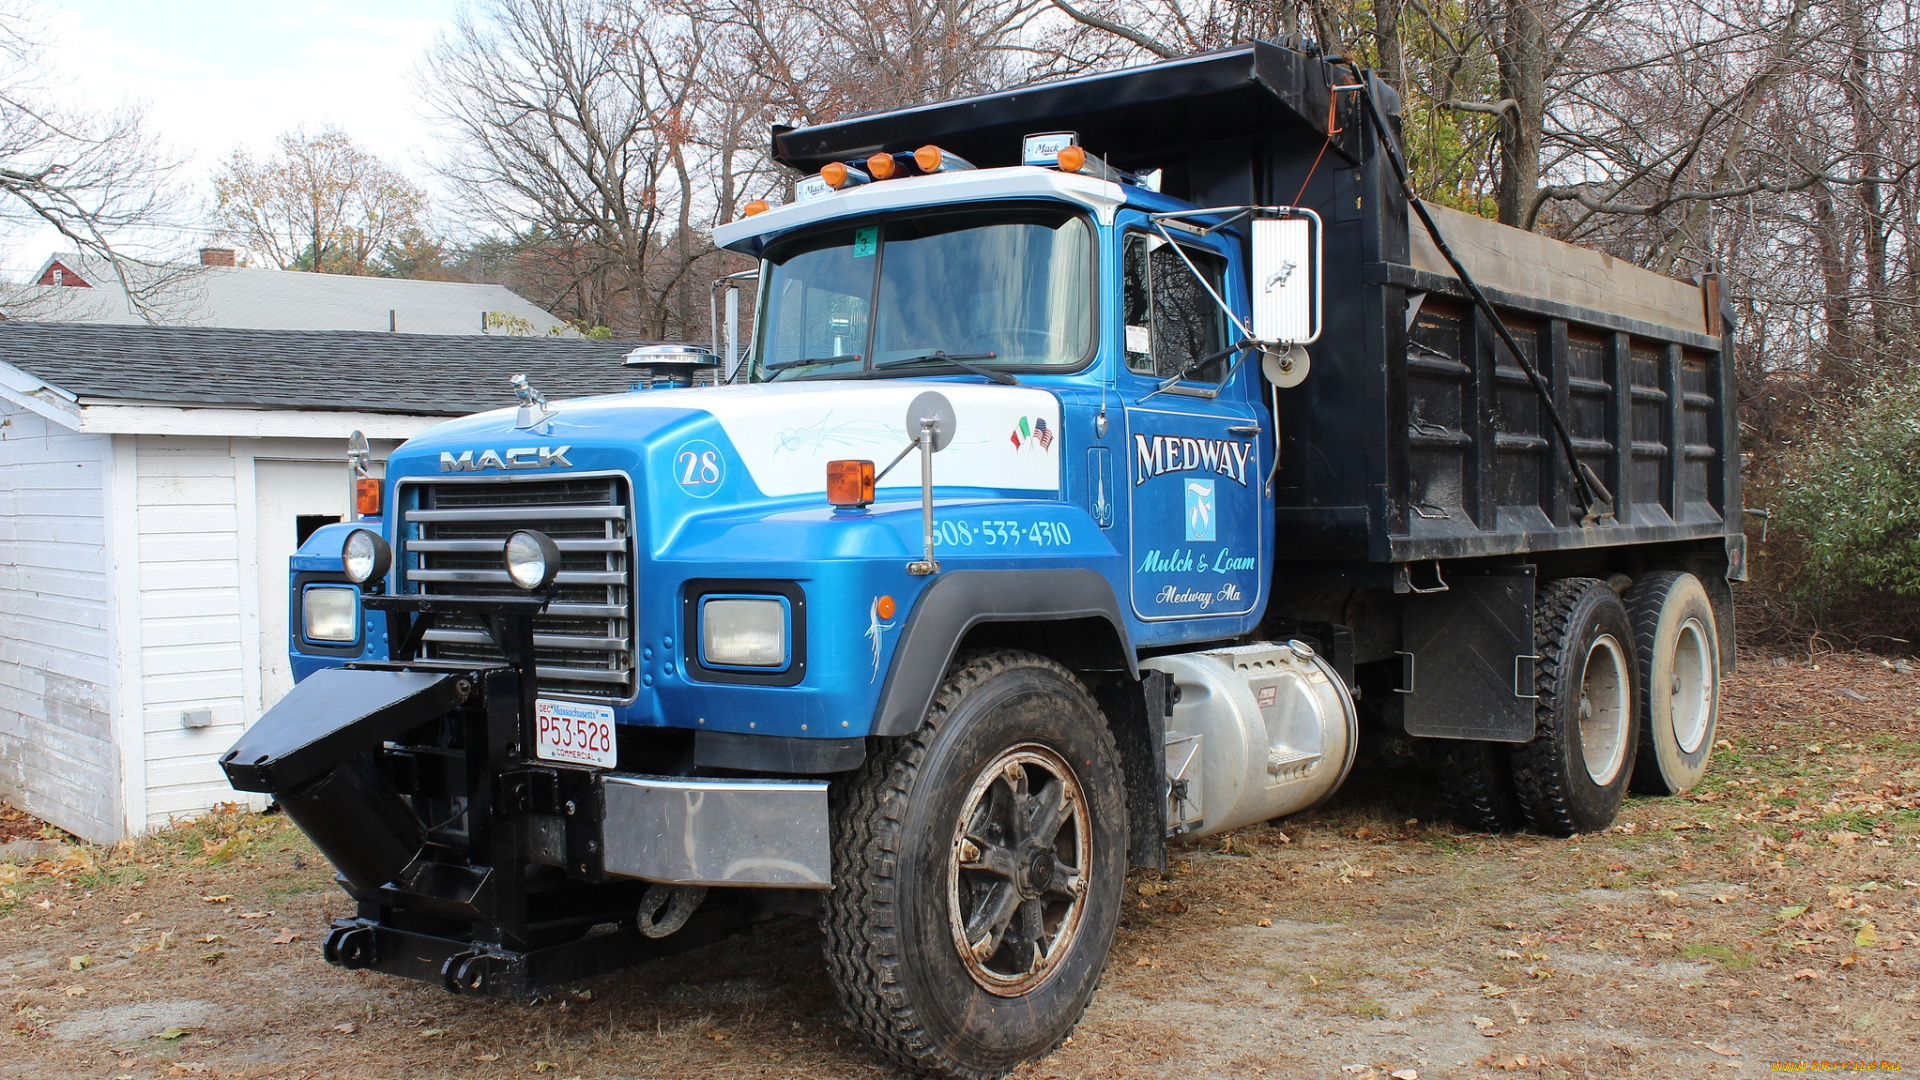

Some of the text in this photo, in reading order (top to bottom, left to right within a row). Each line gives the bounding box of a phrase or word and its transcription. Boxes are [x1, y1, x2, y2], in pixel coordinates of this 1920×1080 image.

[1035, 143, 1060, 156] Mack
[440, 445, 573, 473] MACK
[679, 450, 721, 486] 28
[1133, 433, 1252, 488] MEDWAY
[1136, 547, 1255, 574] Mulch & Loam
[1216, 582, 1241, 602] Ma
[539, 704, 597, 719] DEC Massachusetts
[556, 748, 596, 761] COMMERCIAL
